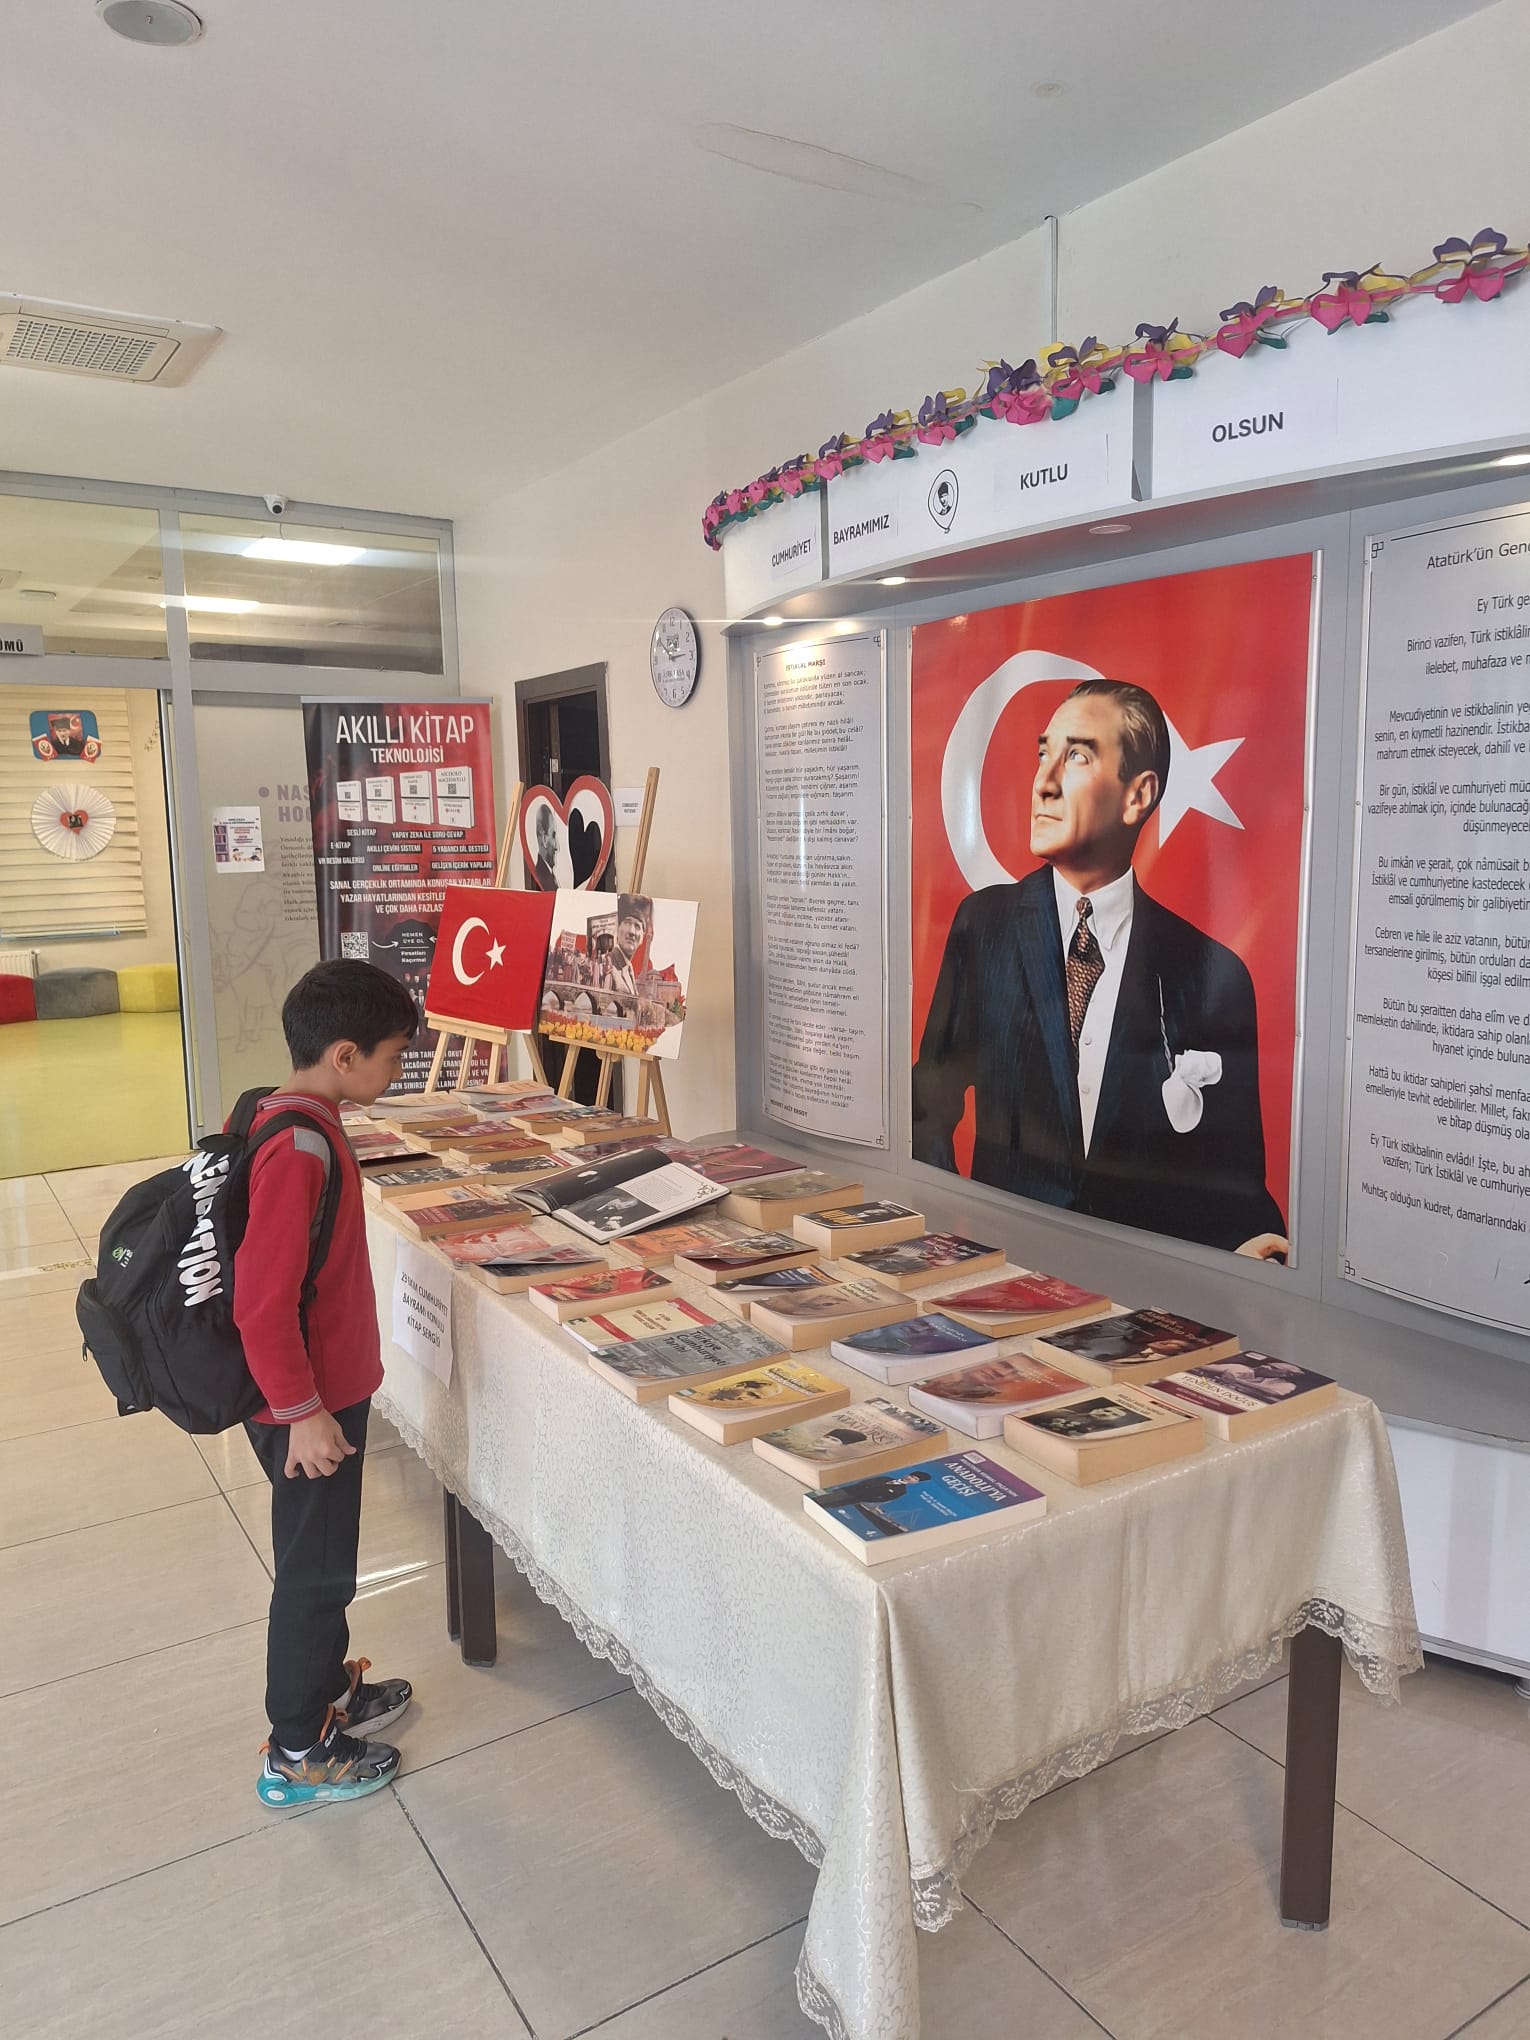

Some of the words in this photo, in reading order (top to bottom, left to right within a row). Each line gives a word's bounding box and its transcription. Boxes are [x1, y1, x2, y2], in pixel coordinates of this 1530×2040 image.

[1212, 412, 1284, 443] OLSUN
[1019, 464, 1068, 490] KUTLU
[771, 539, 811, 568] CUMHURİYET
[833, 514, 890, 545] BAYRAMIMIZ
[1477, 599, 1488, 614] Ey
[1492, 594, 1513, 609] Türk
[1407, 638, 1431, 651] Birinci
[1434, 633, 1466, 648] vazifen,
[1470, 630, 1491, 644] Türk
[1426, 661, 1458, 675] ilelebet,
[1462, 655, 1506, 671] muhafaza
[1511, 655, 1522, 665] ve
[1390, 707, 1448, 723] Mevcudiyetinin
[1451, 707, 1461, 717] ve
[1465, 702, 1513, 717] istikbalinin
[336, 715, 404, 744] AKILLI
[411, 711, 474, 744] KİTAP
[1375, 730, 1396, 742] senin,
[1400, 730, 1408, 740] en
[1412, 726, 1442, 741] kıymetli
[1446, 722, 1492, 737] hazinendir.
[370, 745, 444, 763] TEKNOLOJİSİ
[1377, 748, 1408, 760] mahrum
[1411, 745, 1435, 758] etmek
[1439, 743, 1481, 759] isteyecek,
[1514, 743, 1525, 752] ve
[1380, 784, 1389, 796] Bir
[1392, 783, 1409, 798] gün,
[1412, 782, 1437, 795] istiklâl
[1440, 784, 1449, 794] ve
[1452, 781, 1505, 796] cumhuriyeti
[1368, 802, 1397, 816] vazifeye
[1400, 802, 1428, 813] atılmak
[1431, 802, 1447, 816] için,
[1450, 801, 1476, 816] içinde
[362, 828, 376, 836] KİTAP
[1379, 856, 1388, 868] Bu
[1391, 856, 1413, 868] imkân
[1416, 859, 1425, 868] ve
[1429, 858, 1454, 872] şerait,
[1457, 858, 1472, 872] çok
[1476, 857, 1519, 871] nâmüsait
[330, 880, 351, 890] SANAL
[352, 879, 386, 891] GERÇEKLİK
[388, 880, 427, 889] ORTAMINDA
[1372, 872, 1395, 886] İstiklâl
[1399, 876, 1407, 886] ve
[1410, 874, 1468, 889] cumhuriyetine
[1472, 877, 1525, 891] kastedecek
[340, 894, 362, 903] YAZAR
[363, 893, 416, 903] HAYATLARINDAN
[1389, 894, 1413, 904] emsali
[1416, 894, 1464, 910] görülmemiş
[1468, 896, 1478, 908] bir
[376, 905, 384, 914] VE
[385, 904, 398, 915] ÇOK
[400, 904, 417, 913] DAHA
[1375, 927, 1401, 940] Cebren
[1405, 931, 1413, 941] ve
[1416, 930, 1430, 942] hile
[1433, 931, 1442, 943] ile
[1445, 933, 1461, 944] aziz
[1465, 935, 1501, 950] vatanın,
[1365, 944, 1412, 959] tersanelerine
[1415, 949, 1447, 964] girilmiş,
[1450, 951, 1475, 965] bütün
[1479, 953, 1515, 968] orduları
[1428, 968, 1453, 982] köşesi
[1456, 970, 1476, 983] bilfiil
[1480, 972, 1501, 987] işgal
[1383, 998, 1405, 1011] Bütün
[1408, 1001, 1418, 1012] bu
[1420, 1003, 1456, 1018] şeraitten
[1460, 1007, 1482, 1021] daha
[1509, 1014, 1520, 1025] ve
[1357, 1012, 1398, 1028] memleketin
[1401, 1018, 1439, 1035] dahilinde,
[1442, 1024, 1474, 1039] iktidara
[1478, 1030, 1502, 1044] sahip
[1467, 1044, 1493, 1060] içinde
[1369, 1065, 1389, 1078] Hattâ
[1392, 1068, 1400, 1081] bu
[1403, 1071, 1427, 1086] iktidar
[1431, 1077, 1466, 1093] sahipleri
[1366, 1082, 1405, 1100] emelleriyle
[1408, 1090, 1430, 1105] tevhit
[1433, 1096, 1477, 1113] edebilirler.
[1481, 1102, 1508, 1120] Millet,
[1437, 1115, 1447, 1125] ve
[1450, 1115, 1472, 1132] bîtap
[1475, 1120, 1512, 1139] düşmüş
[1370, 1134, 1379, 1146] Ey
[1382, 1136, 1399, 1151] Türk
[1401, 1141, 1443, 1160] istikbalinin
[1446, 1150, 1475, 1167] evlâdı!
[1479, 1154, 1498, 1174] İşte,
[1503, 1162, 1514, 1175] bu
[1383, 1155, 1412, 1173] vazifen;
[1415, 1161, 1433, 1176] Türk
[1436, 1163, 1463, 1183] İstiklâl
[1467, 1175, 1477, 1185] ve
[1362, 1182, 1388, 1201] Muhtaç
[1390, 1190, 1421, 1208] olduğun
[1424, 1198, 1453, 1219] kudret,
[1457, 1207, 1526, 1232] damarlarındaki
[401, 1272, 407, 1283] 29
[418, 1286, 448, 1317] CUMHURİYET
[403, 1293, 426, 1316] BAYRAMI
[407, 1314, 421, 1332] KİTAP
[677, 1335, 727, 1365] Cumhuriyeti
[690, 1330, 721, 1351] Türkiye
[942, 1475, 980, 1496] GEÇİŞİ
